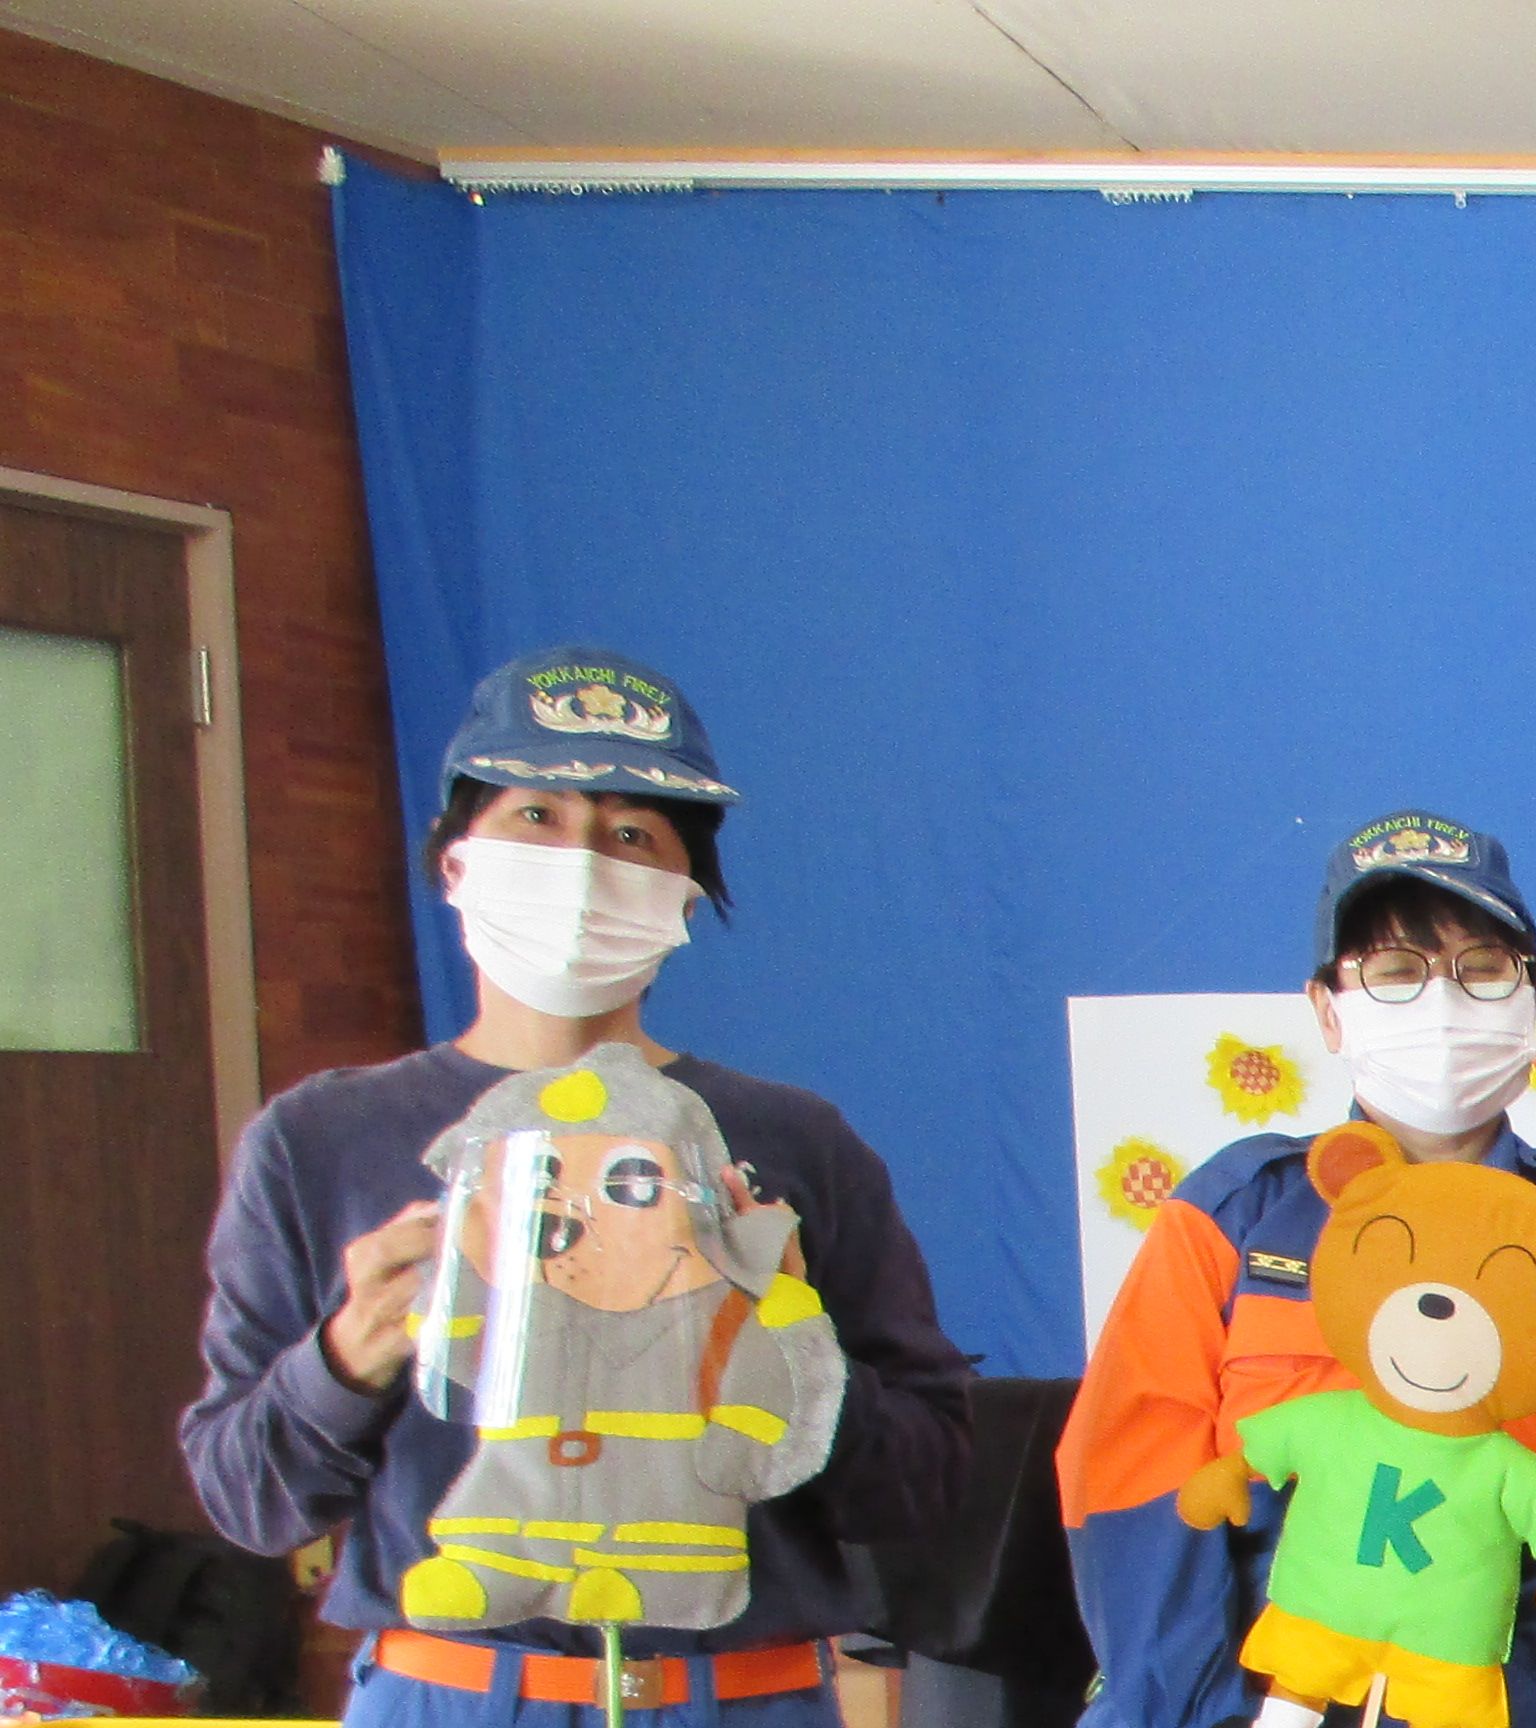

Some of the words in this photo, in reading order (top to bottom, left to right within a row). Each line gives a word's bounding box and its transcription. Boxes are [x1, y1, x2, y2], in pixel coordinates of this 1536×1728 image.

[527, 665, 616, 691] YOKKAICHI
[1349, 815, 1421, 849] YOKKAICHI
[1356, 1462, 1448, 1576] K
